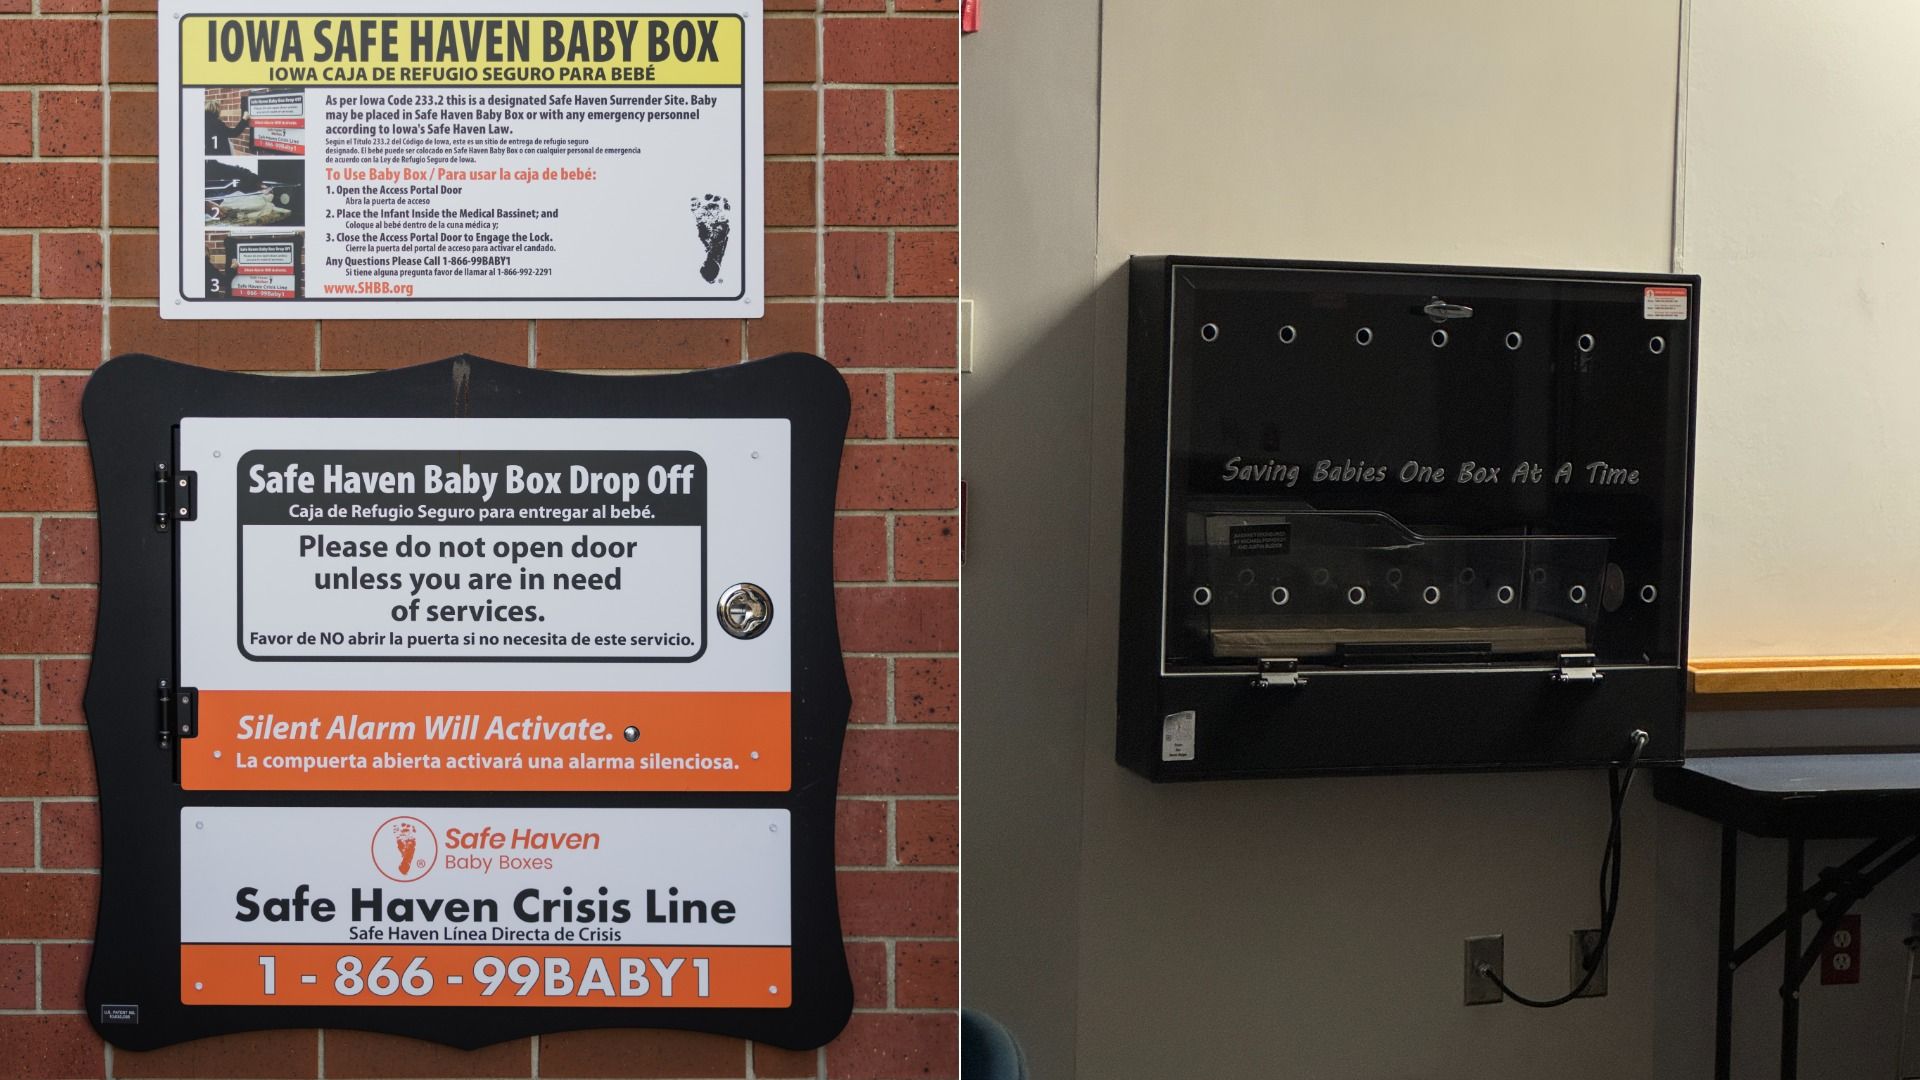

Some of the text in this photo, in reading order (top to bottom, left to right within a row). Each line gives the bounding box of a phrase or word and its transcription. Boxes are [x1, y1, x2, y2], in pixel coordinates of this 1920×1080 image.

[208, 20, 719, 63] IOWA SAFE HAVEN BABY BOX
[270, 65, 655, 81] IOWA CAJA DE REFUGIO SEGURO PARA BEBÉ
[326, 94, 717, 108] As per Iowa Code 233.2 this is a designated Safe Haven Surrender Site. Baby
[326, 123, 513, 137] according to Iowa's Safe Haven Law.
[211, 136, 218, 150] 1
[325, 168, 341, 180] To
[344, 168, 366, 180] Use
[369, 167, 400, 184] Baby
[403, 167, 427, 180] Box
[438, 167, 466, 180] Para
[469, 171, 497, 180] usar
[500, 167, 511, 180] la
[514, 167, 539, 184] caja
[542, 167, 558, 180] de
[560, 167, 596, 180] bebé:
[326, 185, 462, 197] 1. Open the Access Portal Door
[211, 207, 220, 220] 2
[326, 208, 558, 219] 2. Place the Infant Inside the Medical Bassinet; and
[326, 232, 553, 245] 3. Close the Access Portal Door to Engage the Lock.
[326, 256, 510, 268] Any Questions Please Call 1-866-99BABY1
[346, 268, 552, 278] Si tiene alguna pregunta favor de llamar al 1-866-992-2291
[210, 278, 220, 292] 3
[324, 282, 413, 296] www.SHBB.org
[1222, 456, 1639, 487] Saving Babies One Box At A Time
[249, 463, 695, 502] Safe Haven Baby Box Drop Off
[289, 504, 655, 522] Caja de Refugio Seguro para entregar al bebé.
[300, 534, 637, 564] Please do not open door
[315, 566, 621, 596] unless you are in need
[391, 598, 545, 622] of services.
[237, 714, 613, 741] Silent Alarm Will Activate.
[236, 752, 739, 773] La compuerta abierta activará una alarma silenciosa.
[445, 826, 600, 849] Safe Haven
[445, 854, 553, 874] Baby Boxes
[235, 884, 736, 924] Safe Haven Crisis Line
[349, 926, 621, 941] Safe Haven Línea Directa de Crisis
[259, 955, 276, 995] 1
[334, 956, 434, 996] 866
[473, 955, 710, 997] 99BABY1
